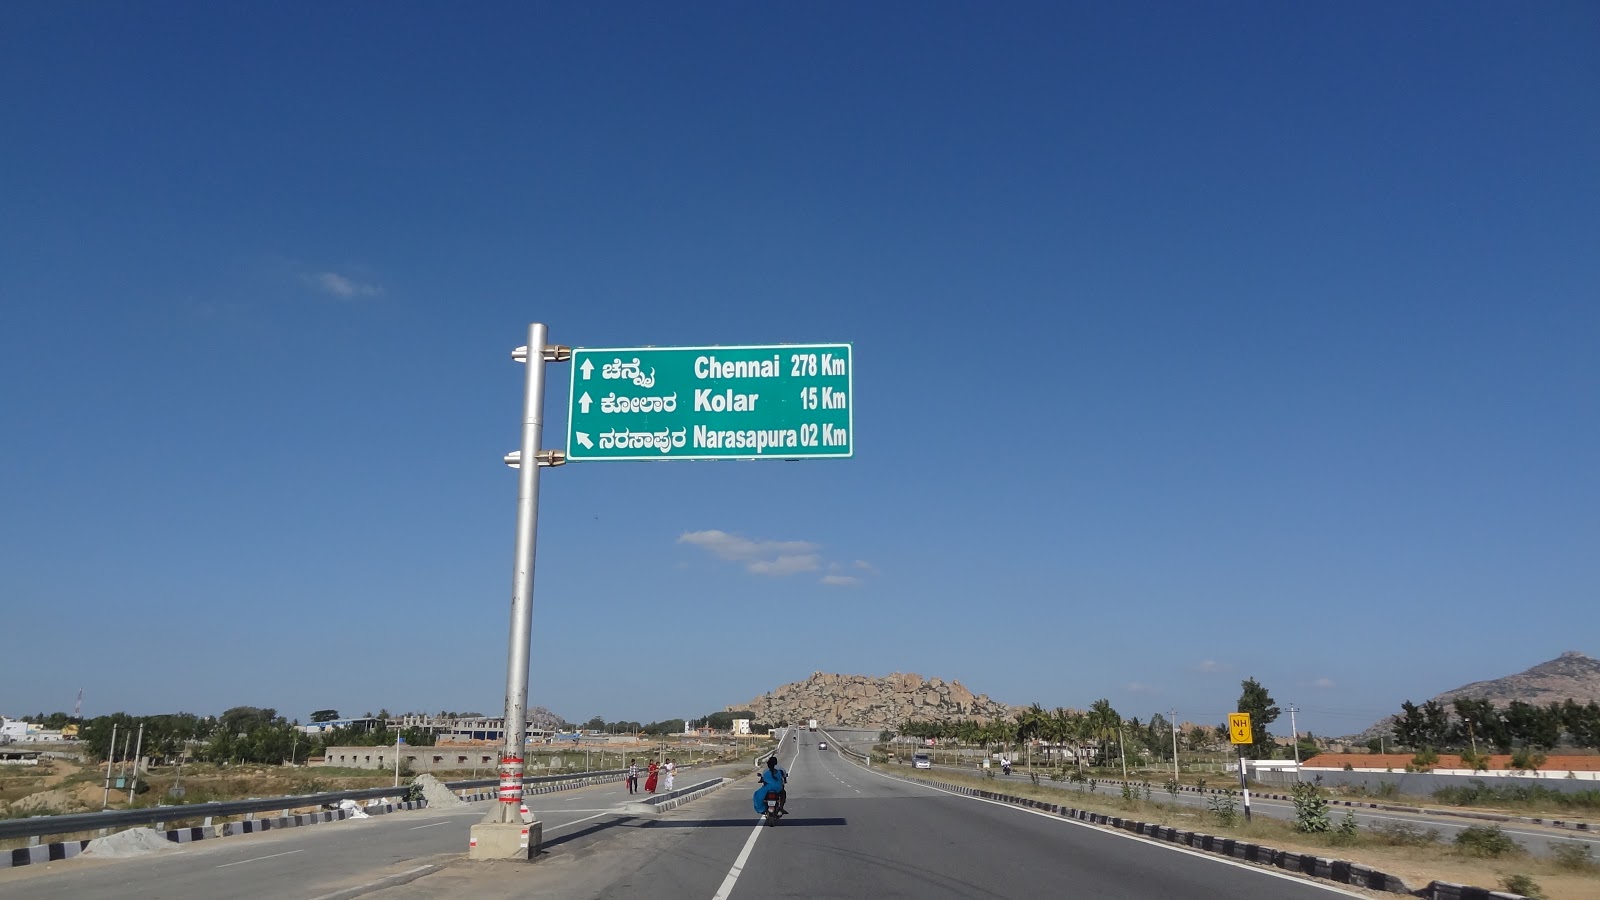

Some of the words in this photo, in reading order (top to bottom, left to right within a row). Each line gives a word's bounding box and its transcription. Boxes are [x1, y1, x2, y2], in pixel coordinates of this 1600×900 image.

[602, 358, 655, 388] ಚೆನ್ನೈ
[694, 355, 779, 379] Chennai
[791, 354, 817, 376] 278
[822, 354, 845, 375] Km
[601, 392, 676, 413] ಕೋಲಾರ
[694, 389, 759, 412] Kolar
[801, 387, 817, 409] 15
[822, 387, 846, 409] Km
[599, 427, 686, 453] ನರಸಾಪುರ
[693, 425, 797, 453] Narasapura
[801, 424, 818, 446] 02
[822, 424, 846, 446] Km
[1238, 729, 1244, 737] 4
